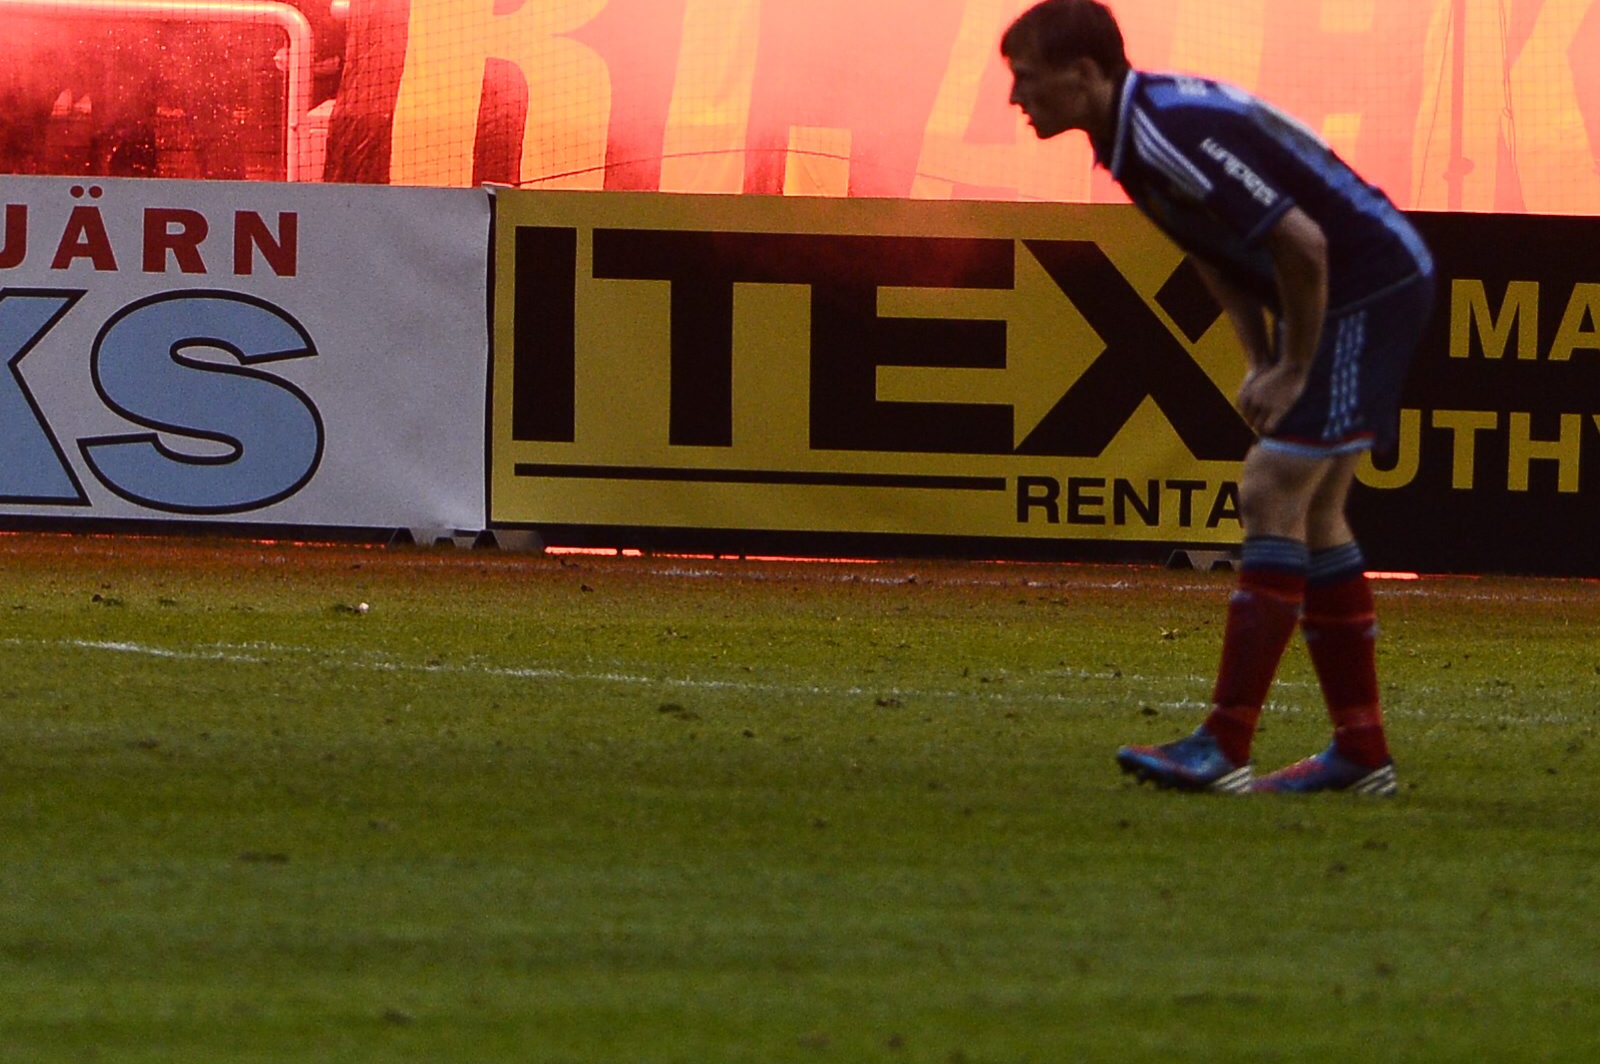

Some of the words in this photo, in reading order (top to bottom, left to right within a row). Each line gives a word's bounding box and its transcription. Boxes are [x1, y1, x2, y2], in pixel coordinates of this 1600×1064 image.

[512, 225, 1259, 462] ITEX
[1449, 278, 1600, 361] MA
[1353, 408, 1600, 493] UTH
[1016, 475, 1244, 529] RENTA
